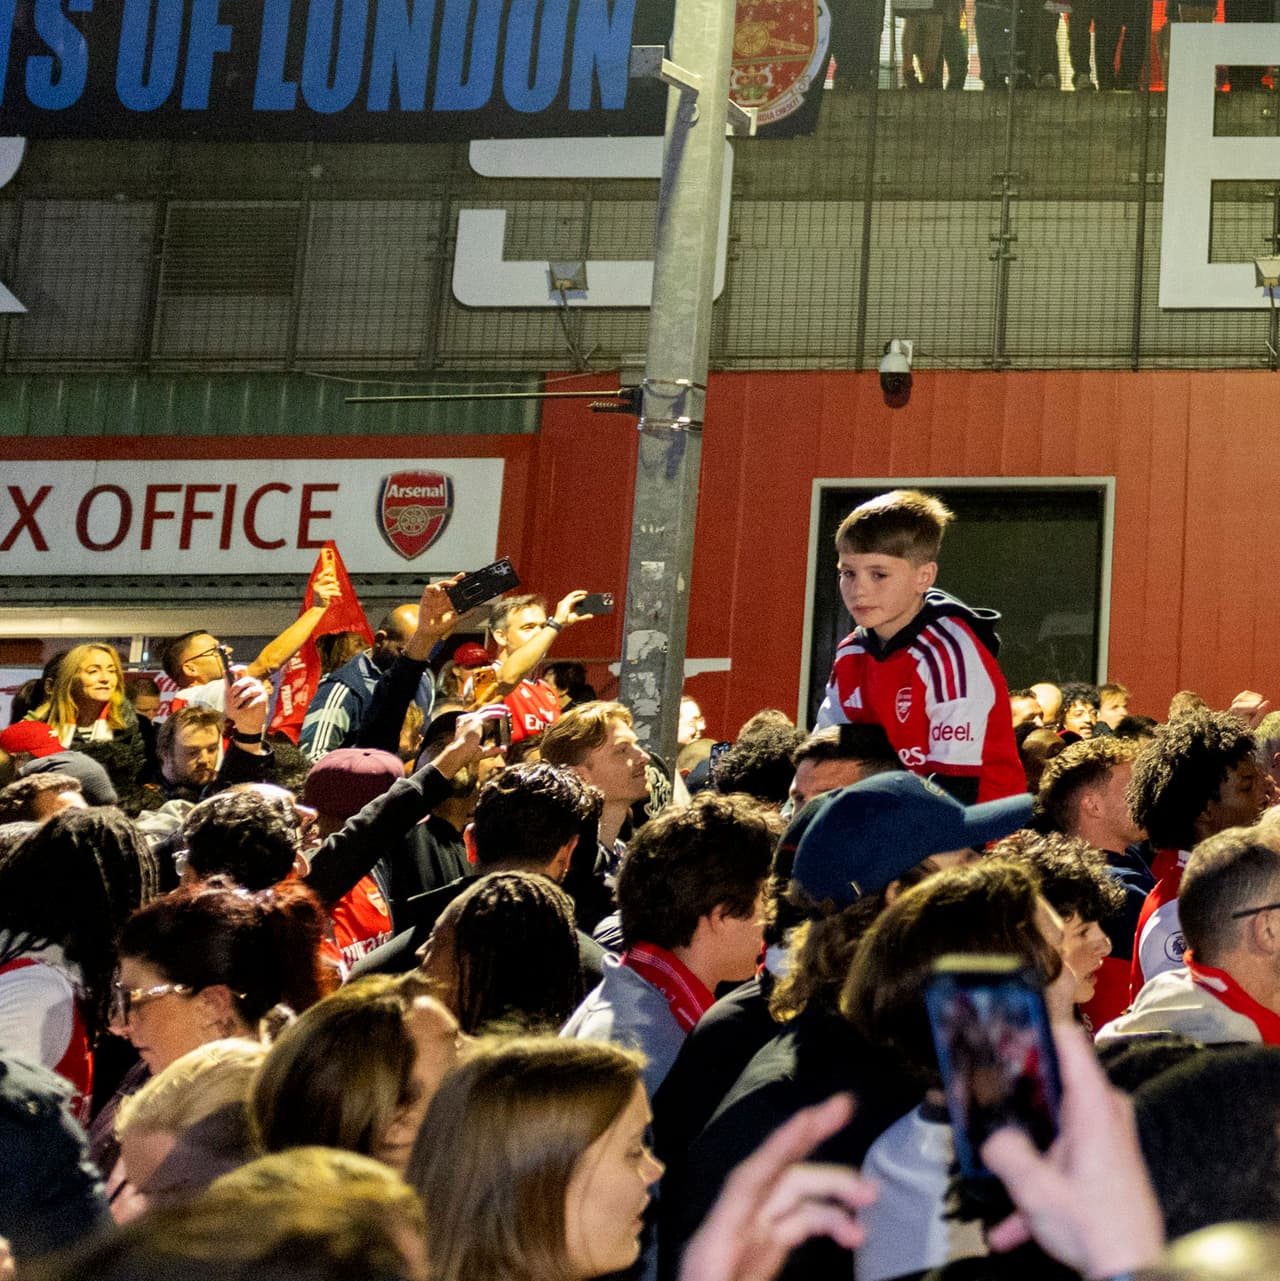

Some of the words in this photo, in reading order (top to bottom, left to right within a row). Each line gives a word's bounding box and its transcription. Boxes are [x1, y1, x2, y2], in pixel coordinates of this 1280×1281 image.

[387, 483, 445, 498] Arsenal
[74, 482, 341, 552] OFFICE
[931, 721, 975, 742] deel.
